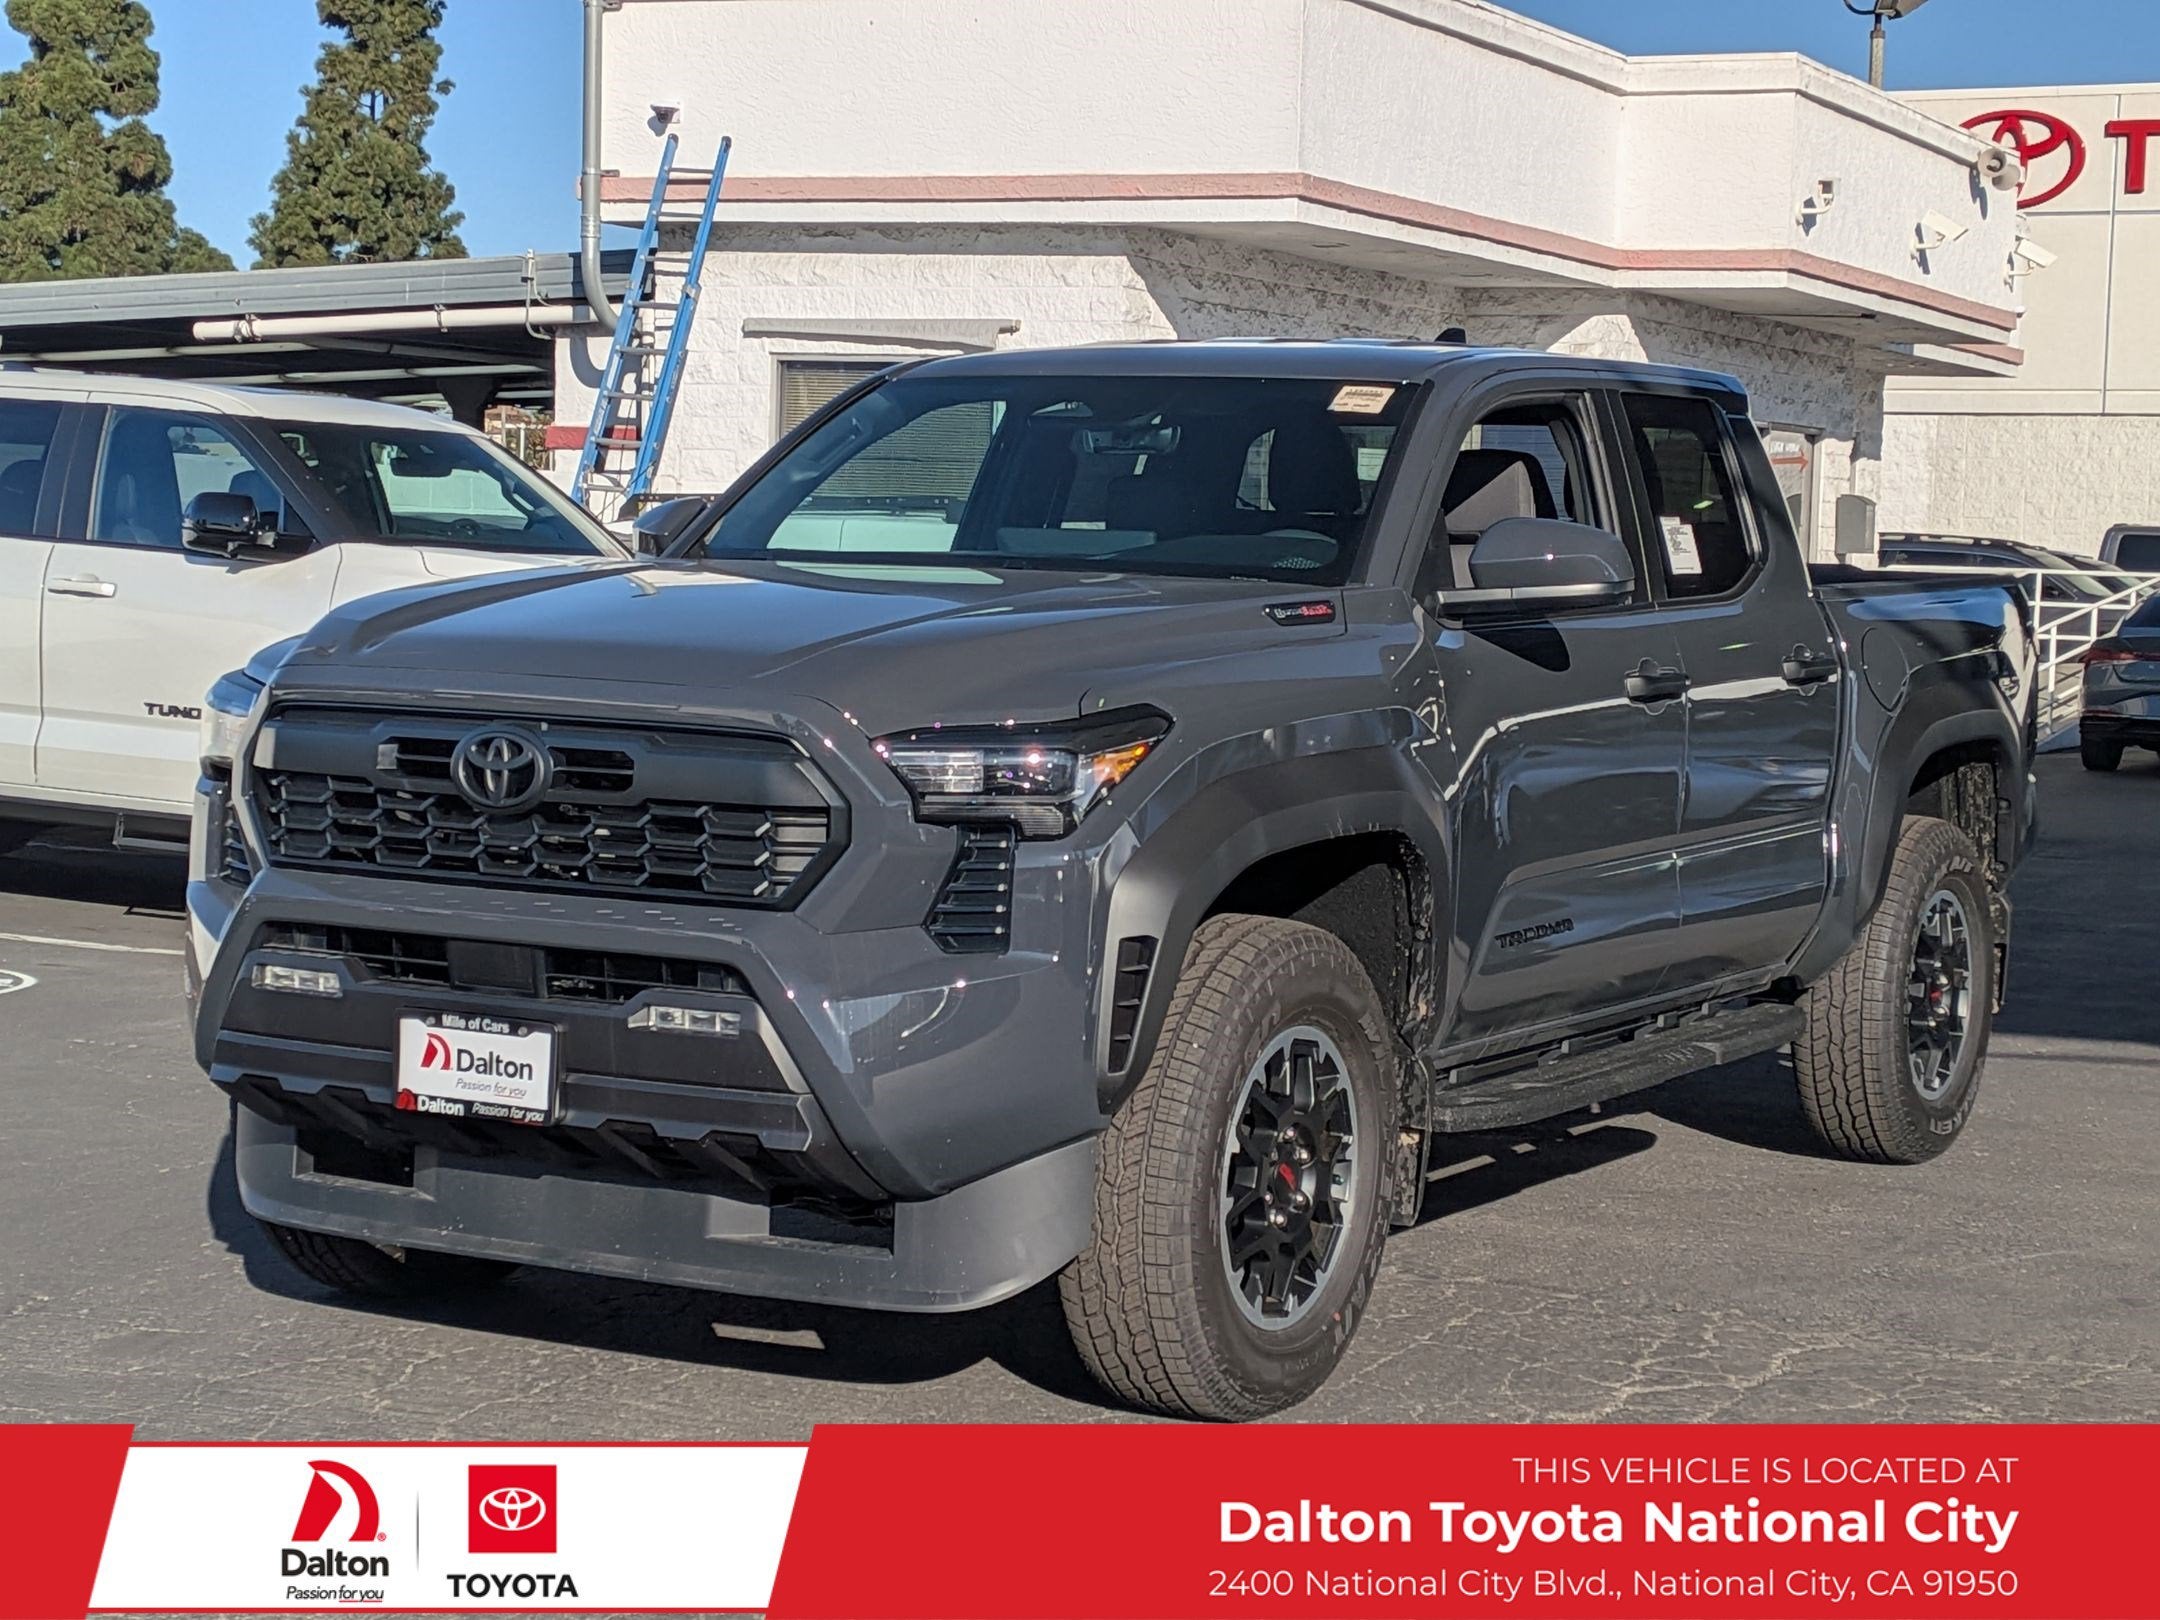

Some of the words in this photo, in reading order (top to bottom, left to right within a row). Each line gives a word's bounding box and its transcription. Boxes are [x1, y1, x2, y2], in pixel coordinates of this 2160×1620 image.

[442, 1013, 466, 1029] Mile
[468, 1018, 481, 1030] of
[481, 1018, 510, 1034] Cars
[456, 1048, 533, 1080] Dalton
[455, 1078, 492, 1092] Passion
[494, 1082, 509, 1094] for
[508, 1087, 528, 1098] you
[417, 1095, 465, 1117] Dalton
[471, 1102, 509, 1118] Passion
[510, 1106, 526, 1119] for
[524, 1110, 545, 1123] you
